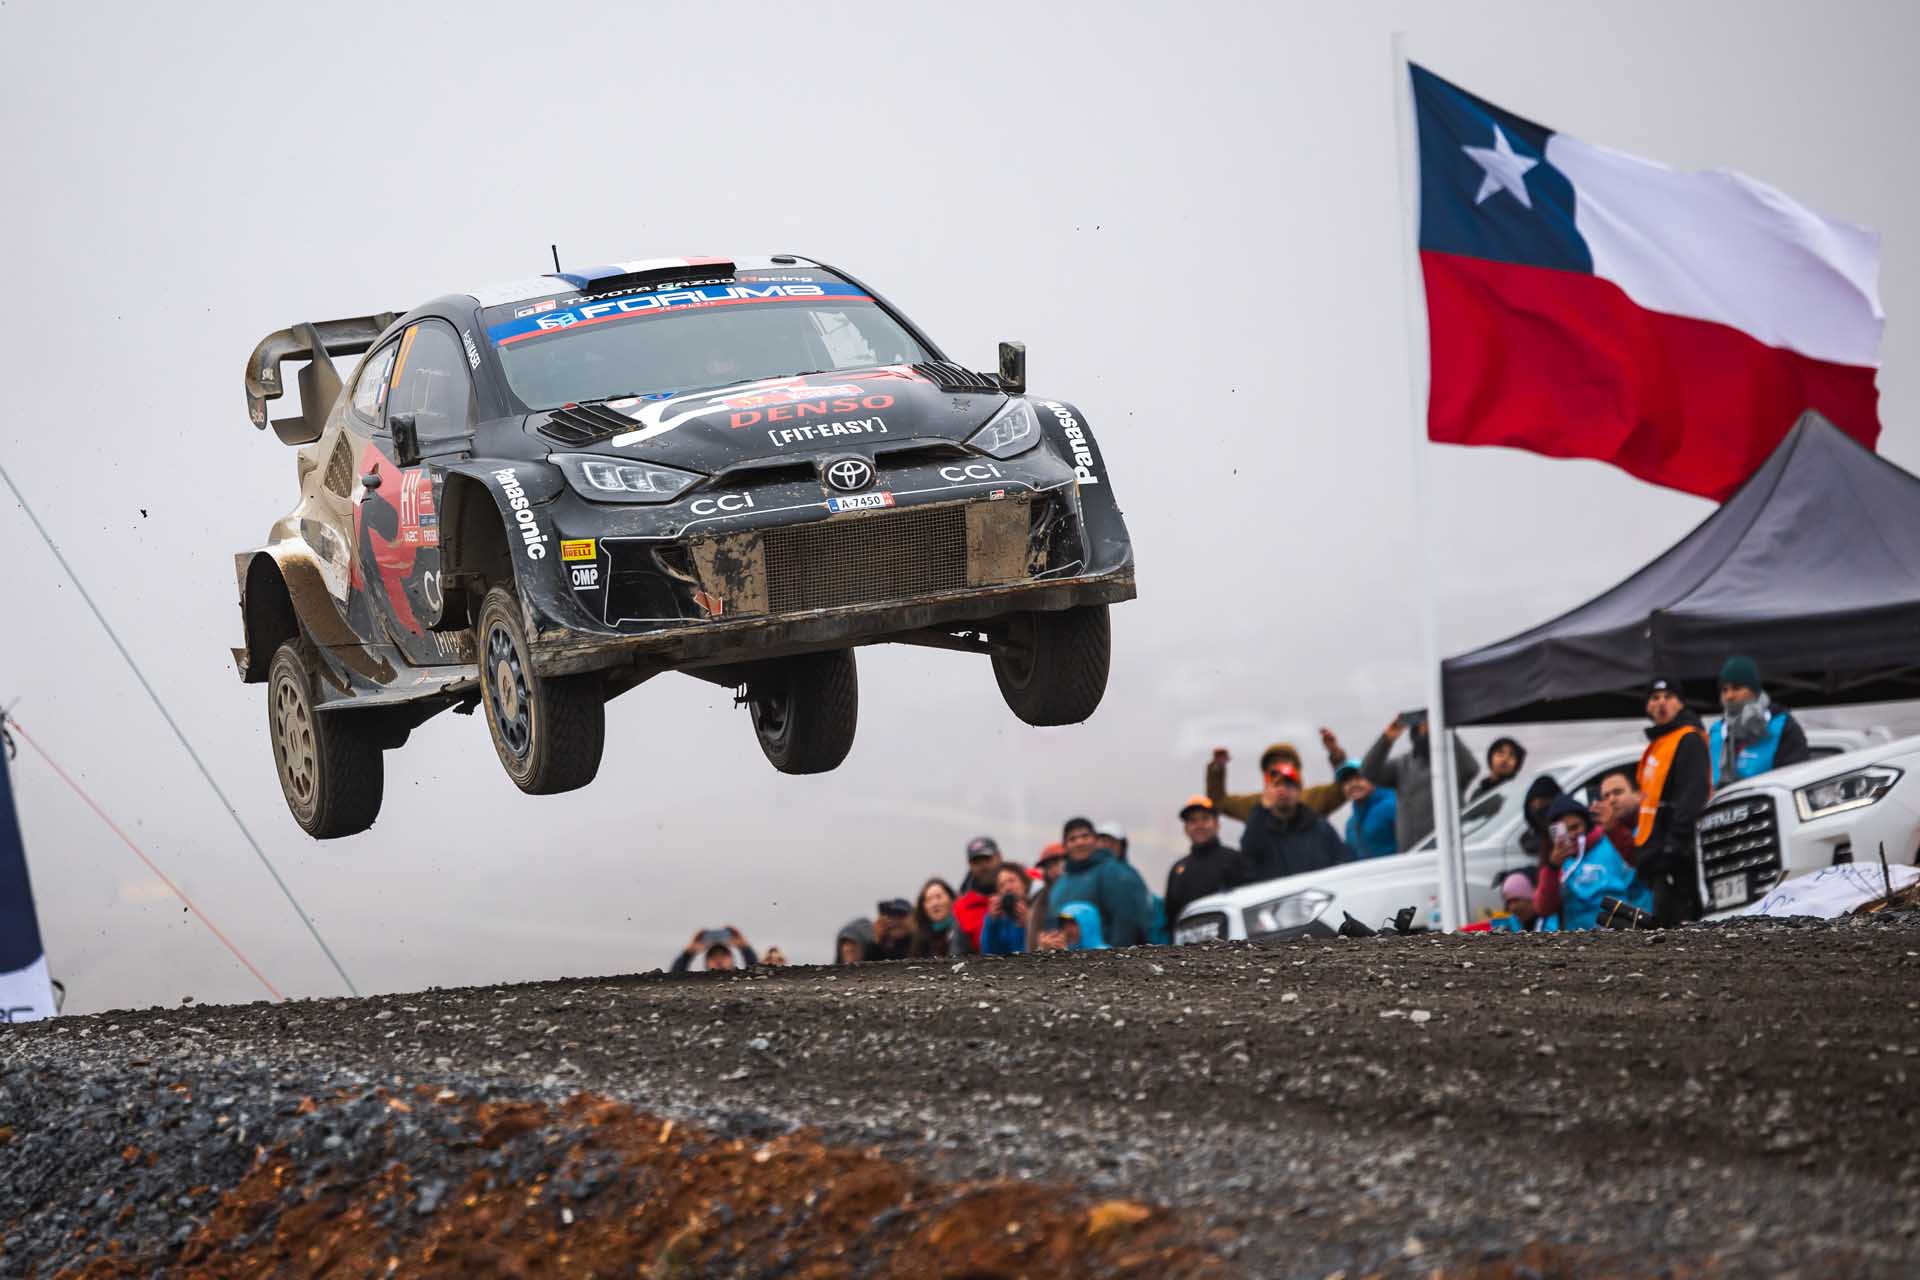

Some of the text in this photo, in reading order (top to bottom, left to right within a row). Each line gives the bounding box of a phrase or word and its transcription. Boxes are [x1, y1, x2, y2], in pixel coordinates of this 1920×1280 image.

[562, 285, 651, 304] TOYOTA
[656, 278, 735, 291] GAZOO
[579, 285, 824, 319] FORUM8
[514, 300, 556, 318] GR
[729, 394, 895, 429] DENSO
[842, 495, 881, 509] A-7450
[490, 468, 549, 560] Panasonic
[563, 543, 592, 558] PIRELLI
[572, 568, 598, 586] OMP
